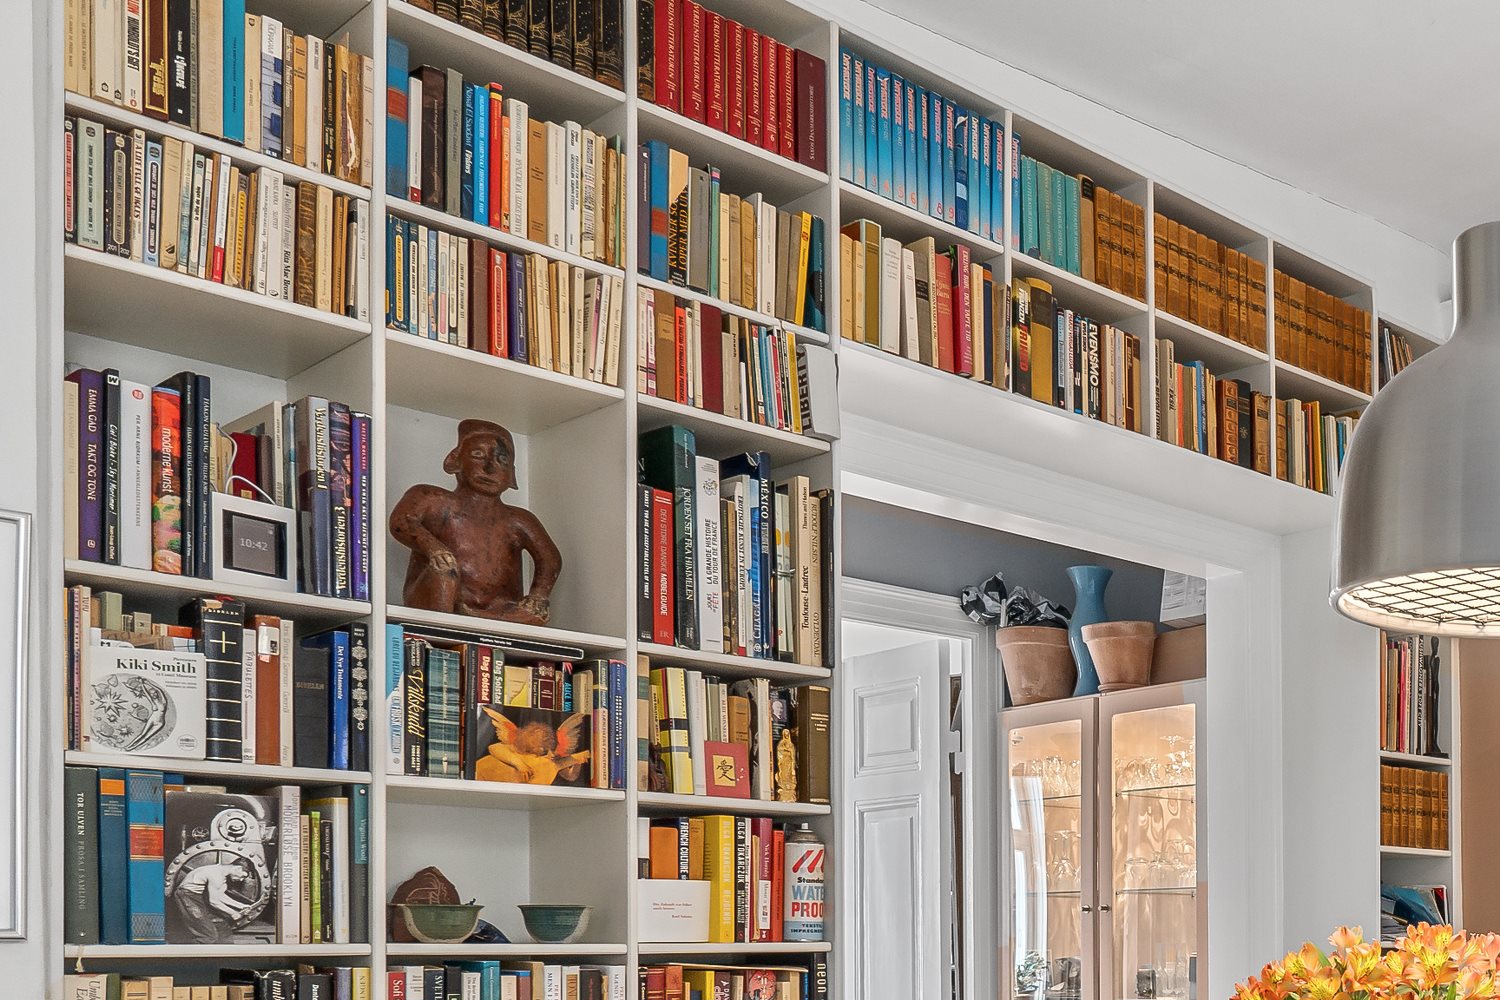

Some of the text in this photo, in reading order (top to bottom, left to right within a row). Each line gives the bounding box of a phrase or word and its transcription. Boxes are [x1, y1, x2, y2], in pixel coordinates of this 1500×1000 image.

[465, 87, 473, 110] Nawal
[134, 186, 142, 194] OF
[962, 250, 971, 272] ERLING
[1018, 323, 1029, 372] FRIHED
[1089, 324, 1099, 386] EVENSMO
[88, 389, 98, 500] EMMA GAD TAKT OG TONE
[162, 428, 174, 493] moderne kunst
[760, 478, 770, 519] MÉXICO
[660, 508, 668, 522] DEN
[812, 503, 820, 534] RUDOLF
[240, 538, 268, 552] 10:42
[660, 524, 668, 545] STORE
[682, 486, 694, 601] JORDEN SET FRA HIMMELEN
[812, 535, 820, 564] NILSEN
[334, 516, 346, 590] Verdenshistorien
[738, 556, 744, 564] IN
[660, 573, 668, 616] MØBELGUIDE
[116, 658, 197, 674] Kiki Smith
[481, 656, 492, 701] Dag Solstad
[494, 660, 504, 704] Dag Solstad
[408, 670, 424, 738] Villskudd
[715, 758, 736, 782] 愛
[76, 792, 84, 808] TOR
[284, 806, 292, 908] MODERLØSE BROOKLYN
[680, 822, 689, 874] FRENCH CULTURE
[737, 821, 745, 883] OLGA TOKARCZUK
[393, 980, 403, 997] Sofi
[568, 976, 577, 1000] TONI
[817, 962, 827, 994] neon
